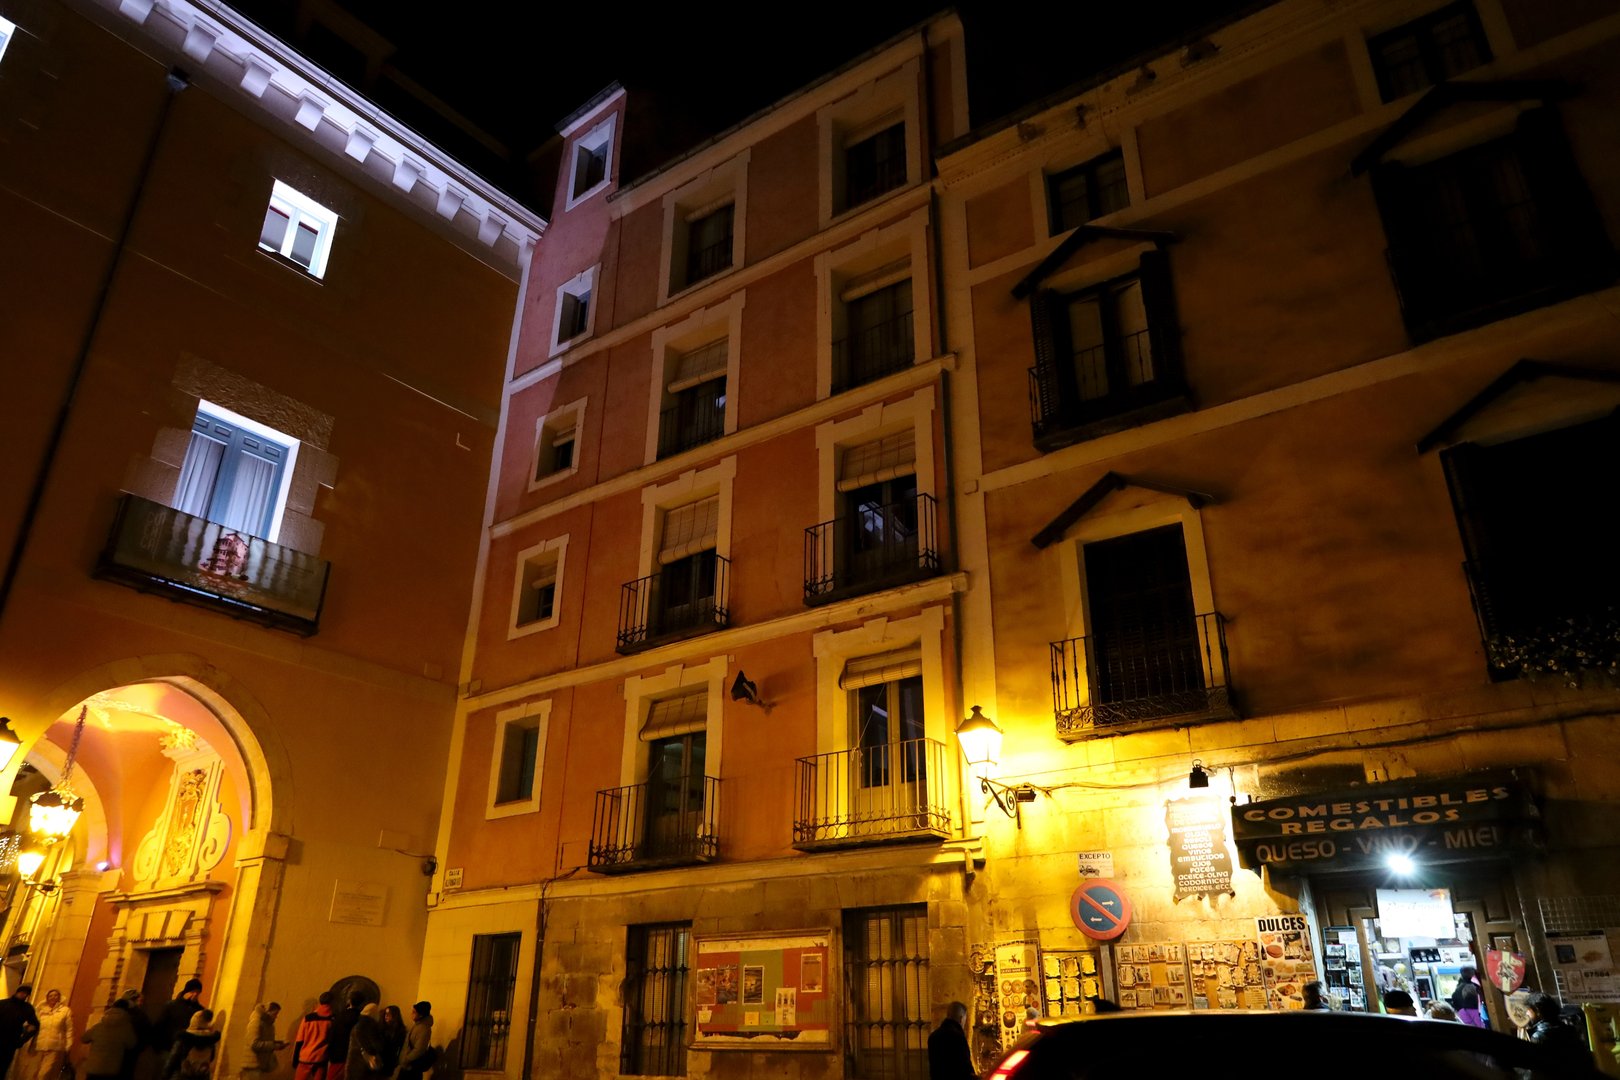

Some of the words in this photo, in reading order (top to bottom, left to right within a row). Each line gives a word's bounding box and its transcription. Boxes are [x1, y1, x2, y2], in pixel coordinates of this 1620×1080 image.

[1373, 770, 1378, 781] 1
[1244, 787, 1510, 822] COMESTIBLES
[1281, 809, 1460, 834] REGALOS
[1188, 848, 1212, 856] VINOS
[1256, 839, 1335, 863] QUESO
[1356, 834, 1419, 855] VINO
[1178, 877, 1230, 887] CODORNICES
[1258, 917, 1305, 932] DULCES
